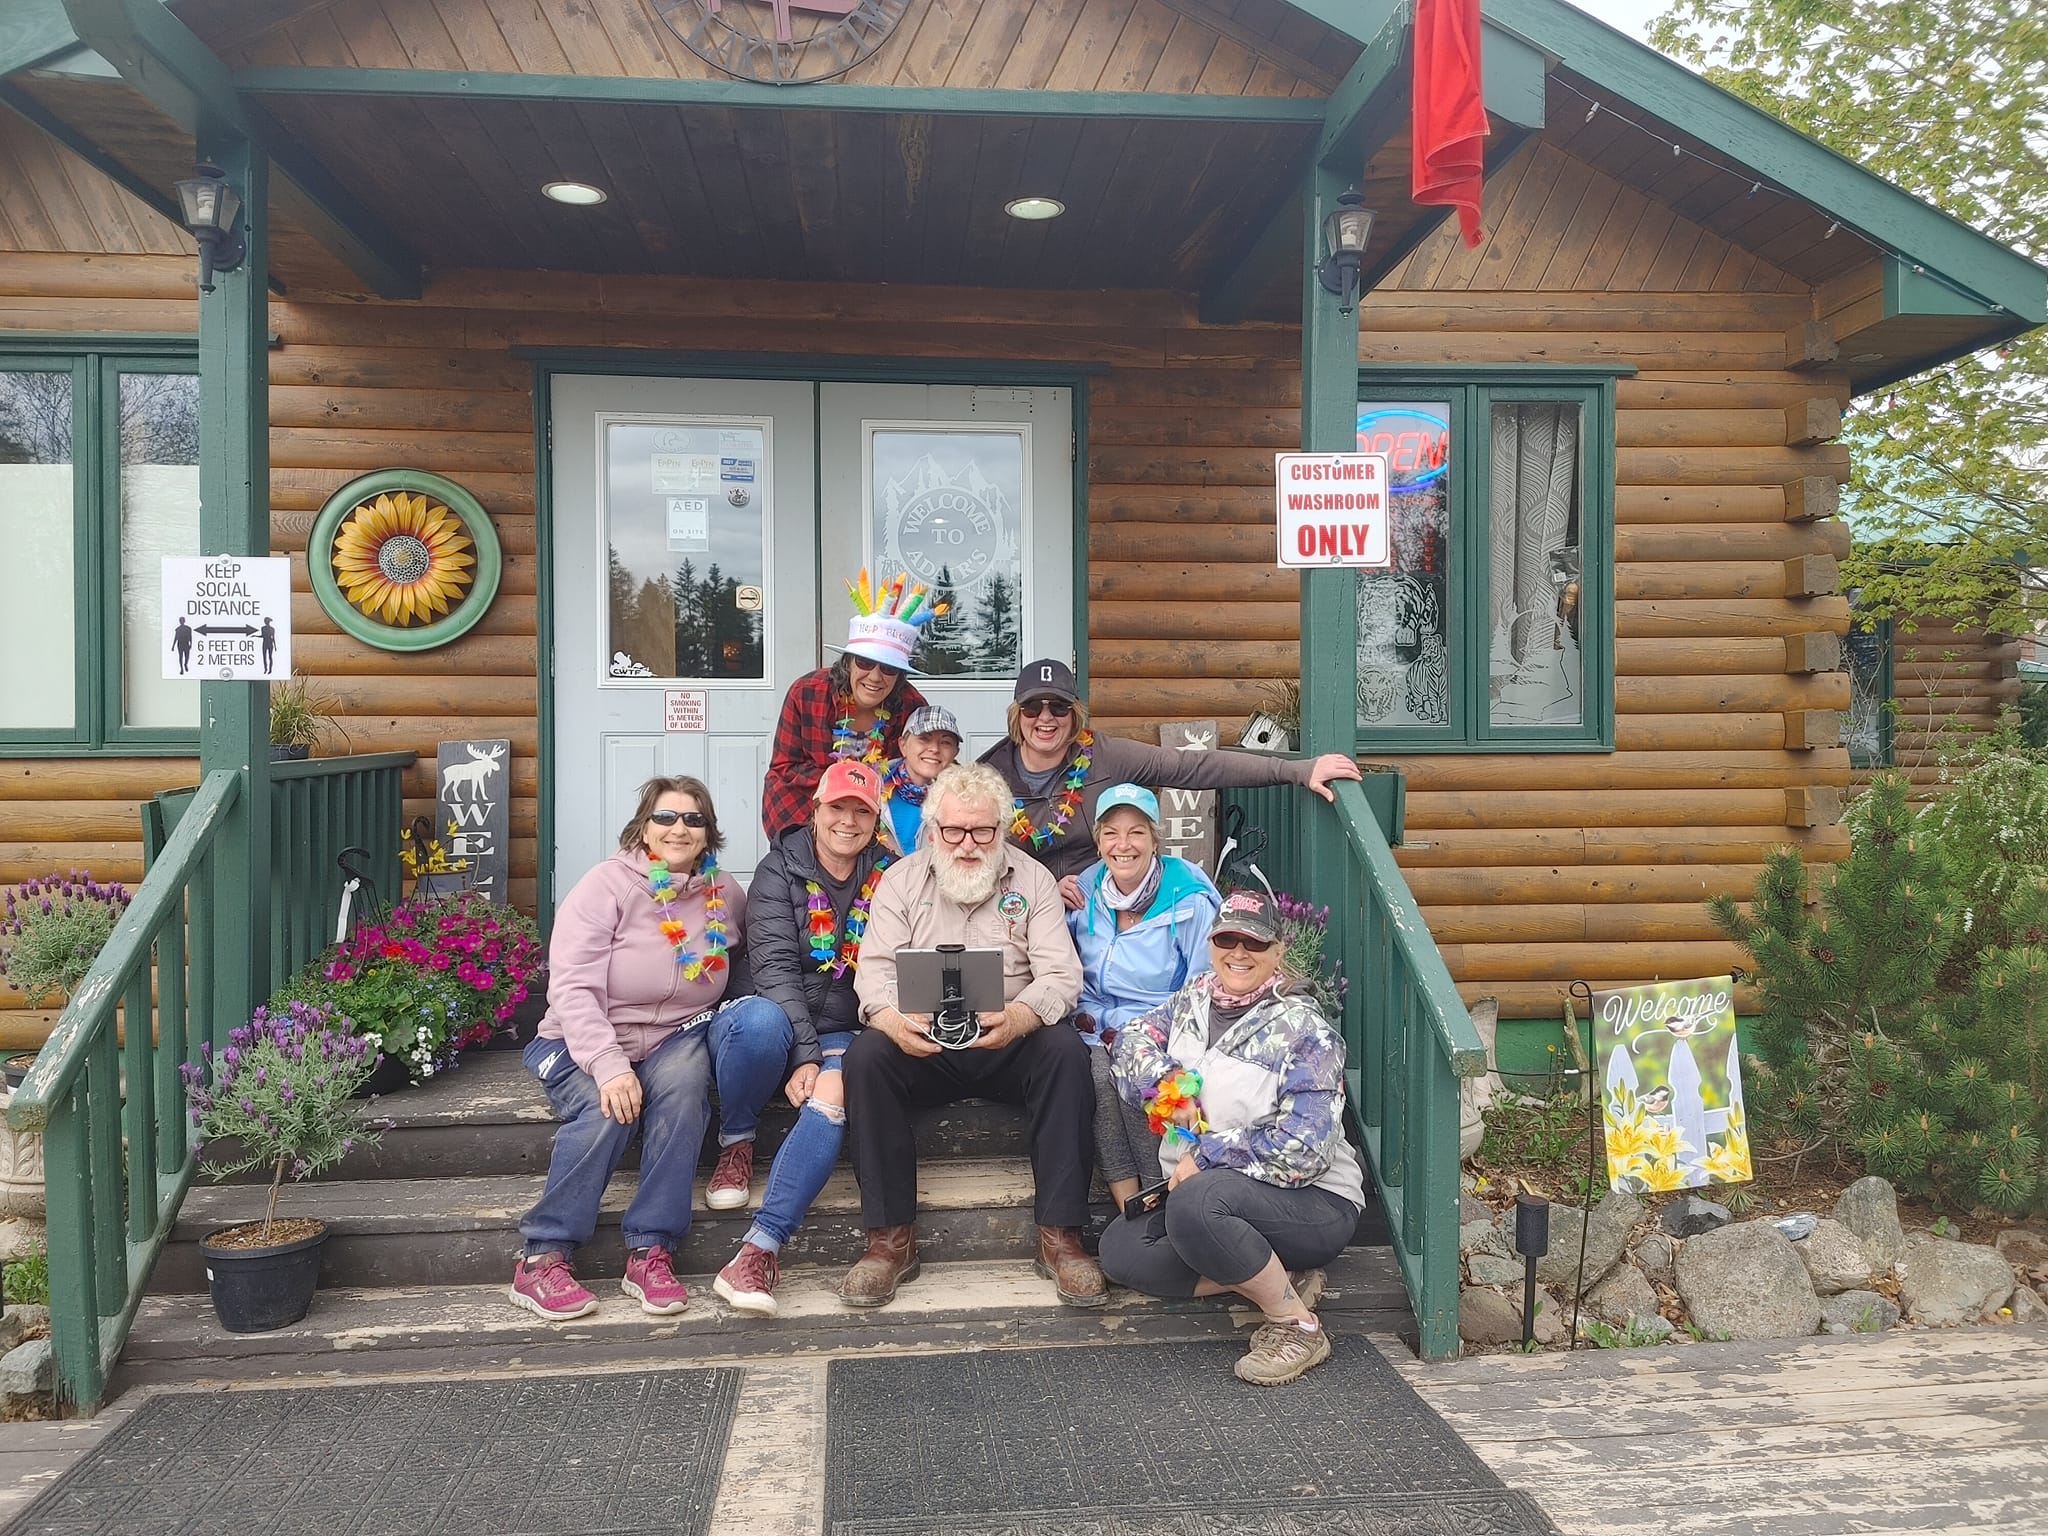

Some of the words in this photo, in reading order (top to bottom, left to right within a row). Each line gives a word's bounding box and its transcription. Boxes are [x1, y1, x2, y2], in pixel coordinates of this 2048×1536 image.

[1291, 463, 1375, 480] CUSTOMER
[673, 501, 703, 511] AED
[1288, 493, 1380, 510] WASHROOM
[903, 493, 991, 535] WELCOME
[932, 528, 965, 545] TO
[1297, 524, 1370, 557] ONLY
[205, 563, 241, 578] KEEP
[906, 548, 988, 583] ADAIR'S
[196, 582, 251, 597] SOCIAL
[187, 600, 261, 615] DISTANCE
[197, 640, 205, 652] 6
[208, 640, 235, 652] FEET
[239, 640, 254, 652] OR
[197, 654, 204, 665] 2
[208, 654, 255, 665] METERS
[670, 721, 678, 729] OF
[680, 721, 702, 729] LODGE
[1603, 990, 1731, 1036] Welcome
